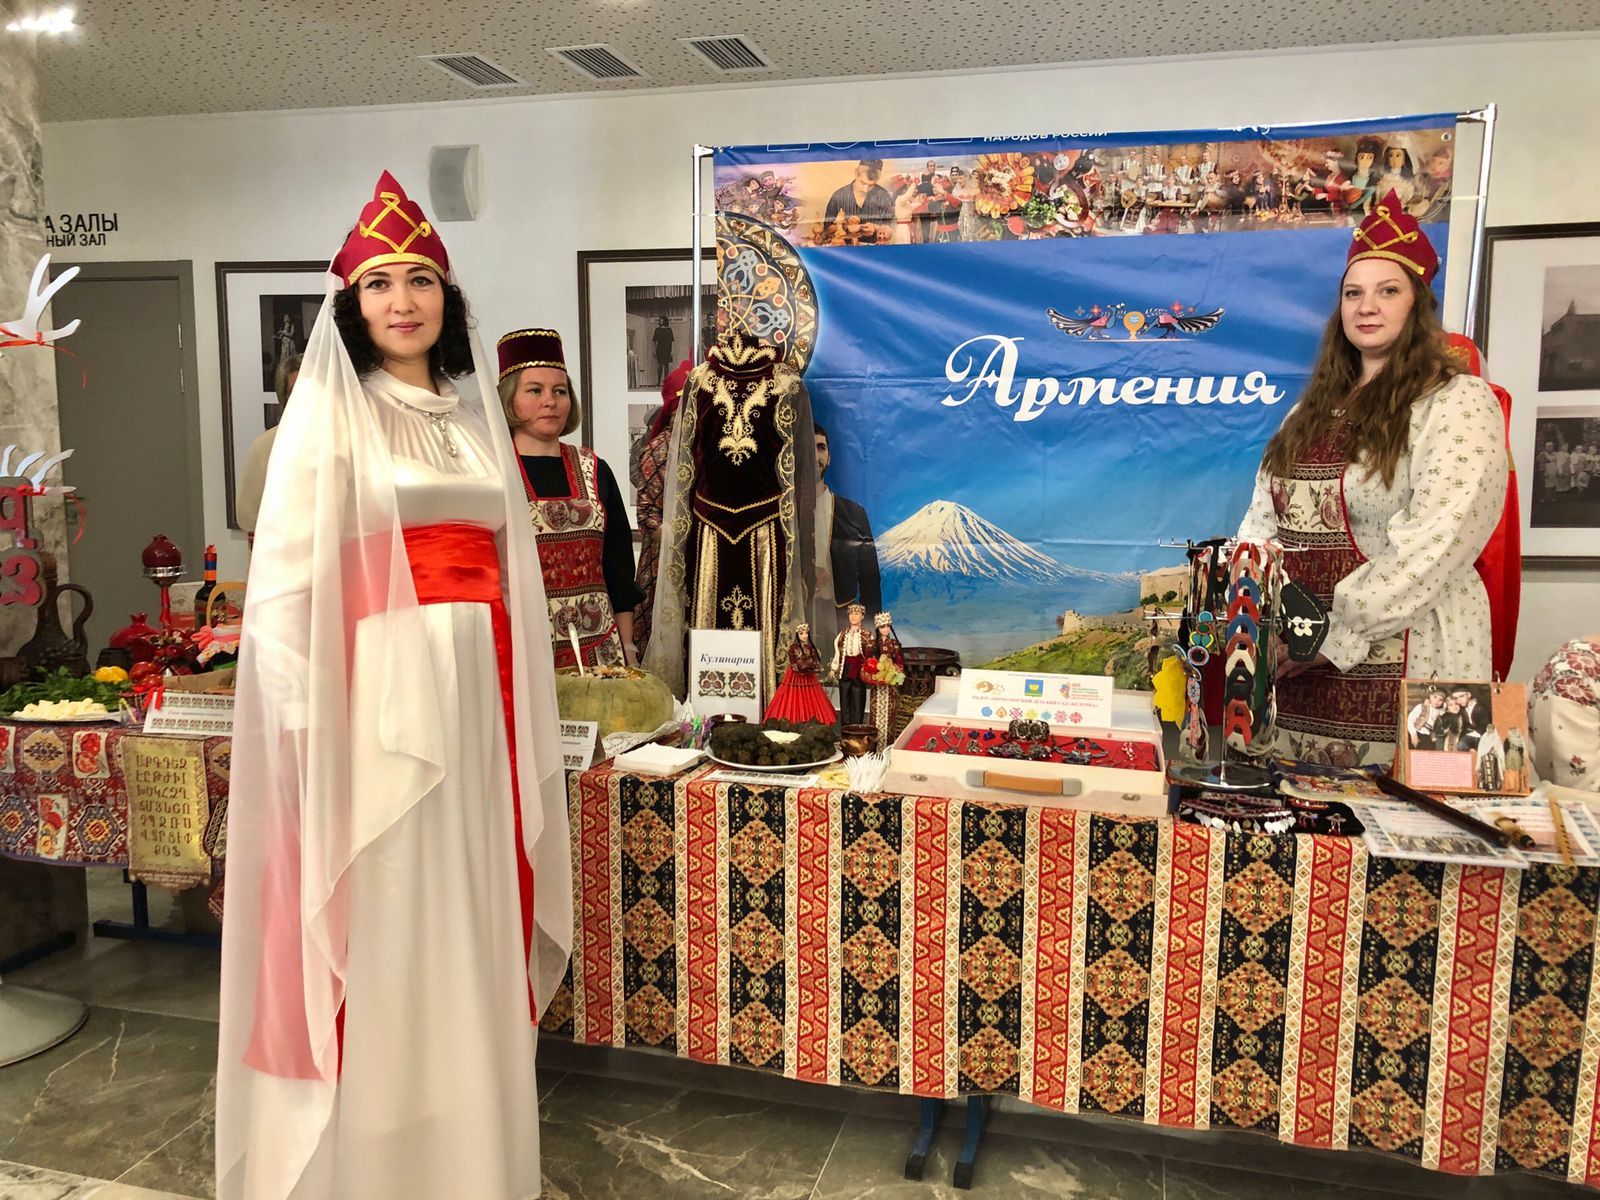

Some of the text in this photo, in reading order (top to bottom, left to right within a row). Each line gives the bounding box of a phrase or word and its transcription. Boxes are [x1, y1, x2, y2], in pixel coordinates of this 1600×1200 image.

[60, 213, 118, 233] ЗАЛЫ
[79, 233, 106, 246] ЗАЛ
[941, 334, 1286, 422] Армения
[700, 653, 755, 666] Кулинария
